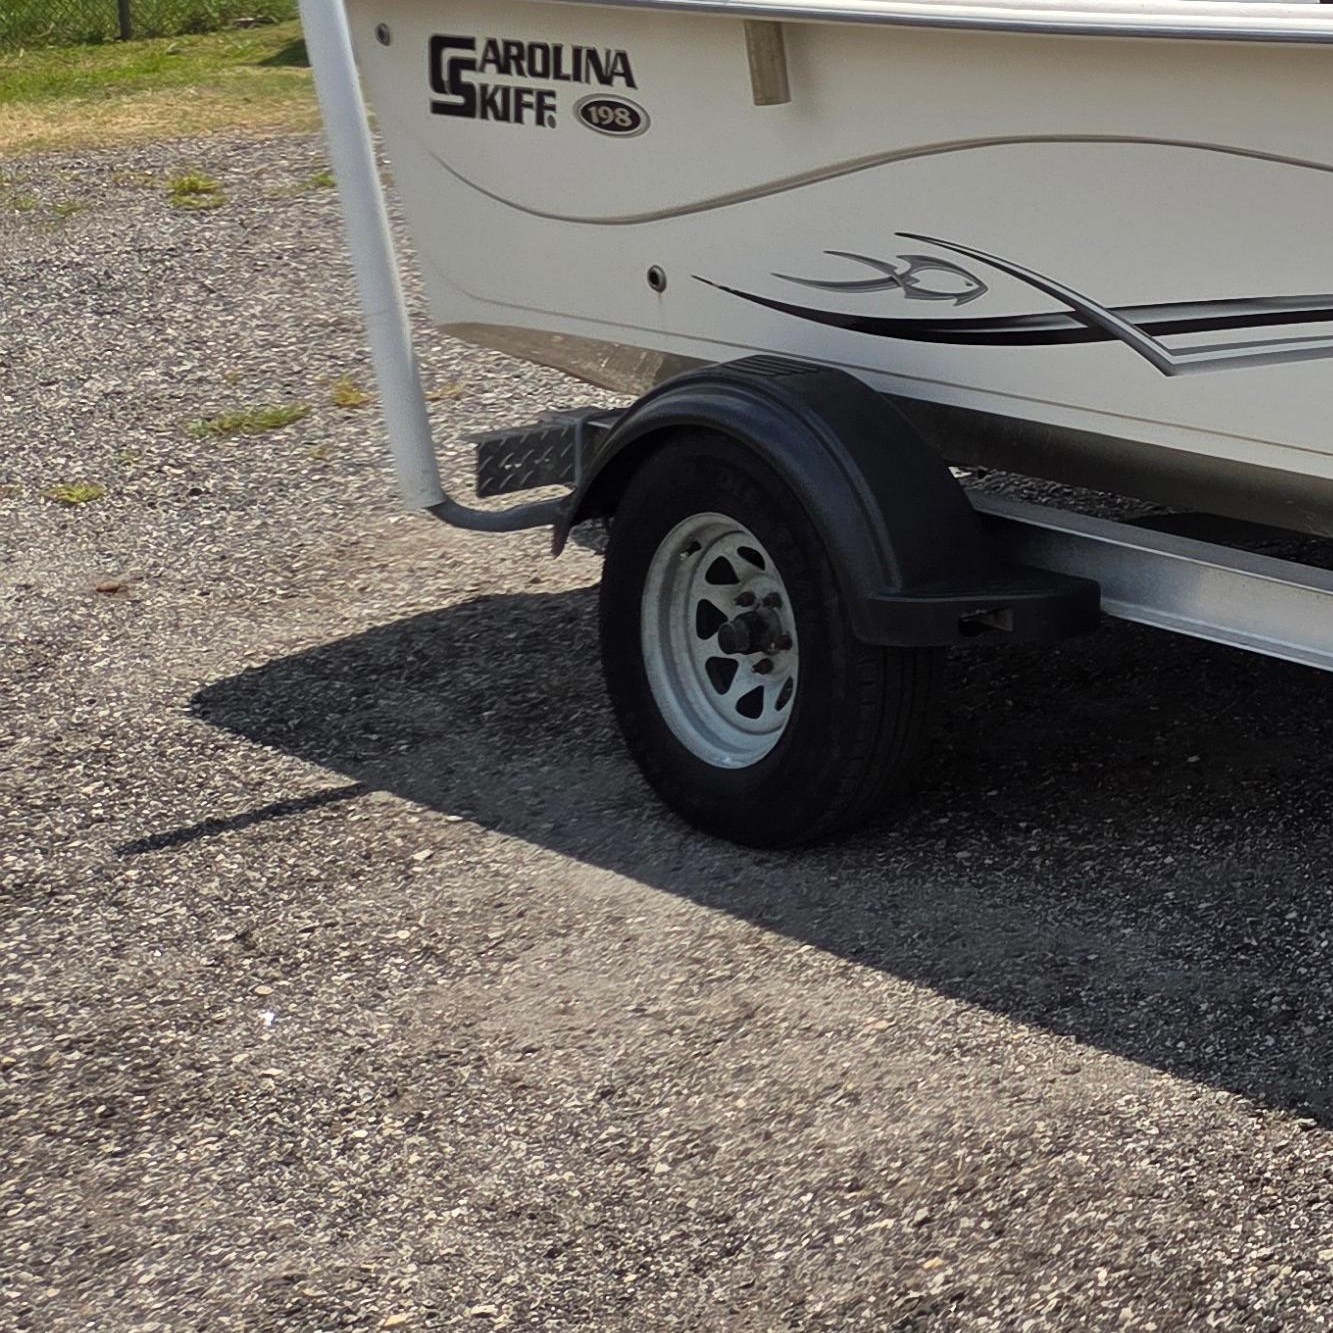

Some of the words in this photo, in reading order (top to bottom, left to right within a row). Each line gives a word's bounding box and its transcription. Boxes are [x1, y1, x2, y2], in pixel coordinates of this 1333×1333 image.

[428, 33, 638, 96] CAROLINA
[429, 57, 557, 129] SKIFF
[587, 102, 633, 129] 198
